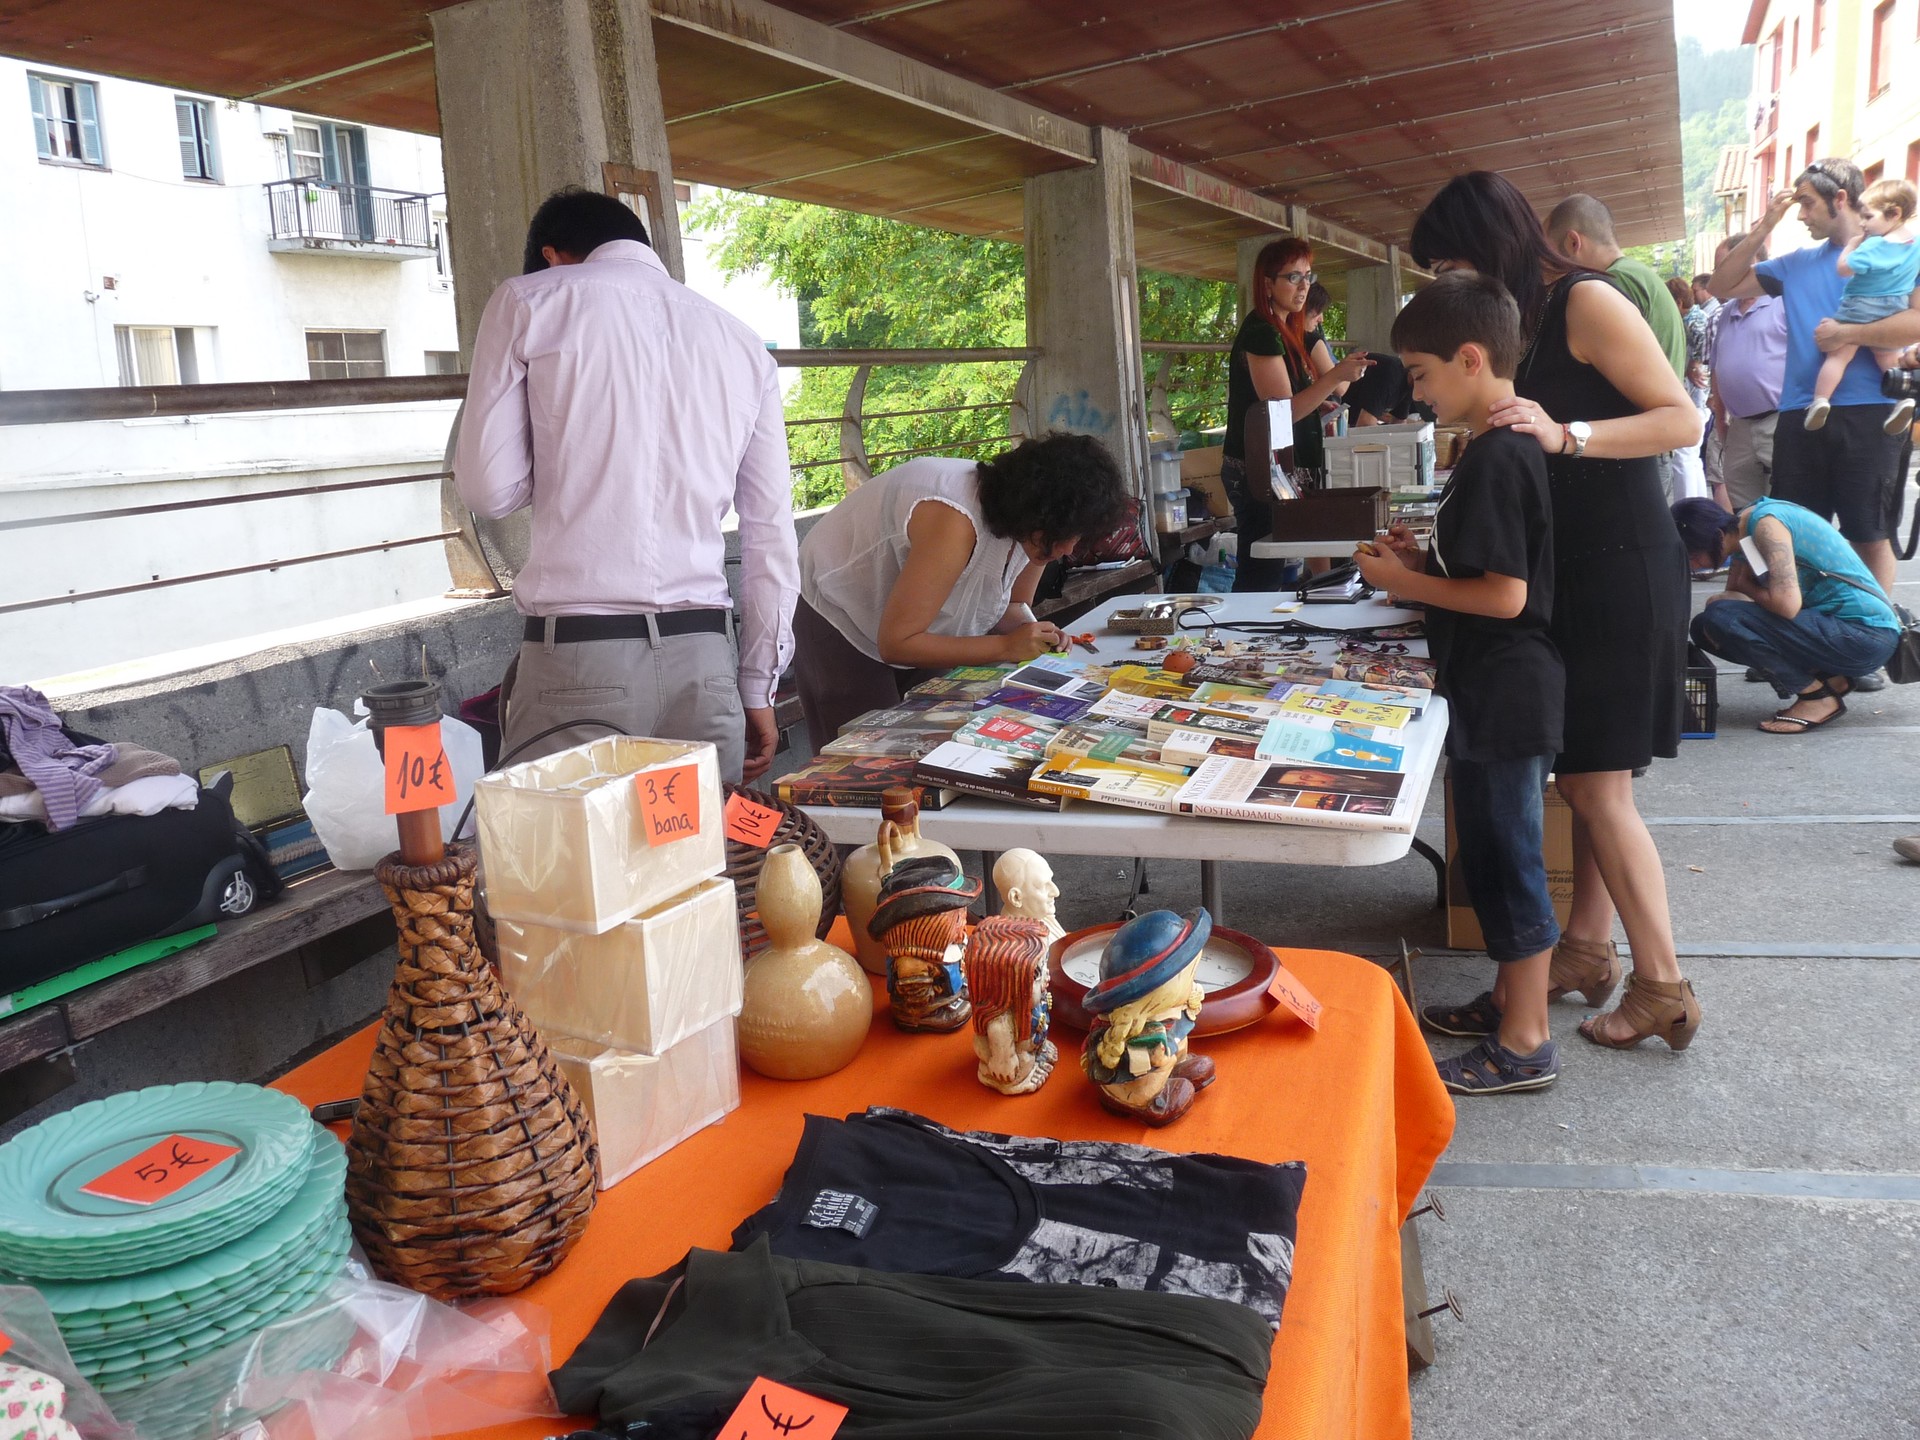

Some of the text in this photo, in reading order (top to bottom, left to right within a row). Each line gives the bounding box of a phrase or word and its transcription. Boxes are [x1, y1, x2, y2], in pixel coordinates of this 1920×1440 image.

[396, 748, 444, 800] 10€
[652, 813, 694, 836] bana
[1194, 804, 1282, 821] NOSTRADAMUS
[134, 1142, 209, 1184] 5€
[819, 1191, 846, 1227] EVENING
